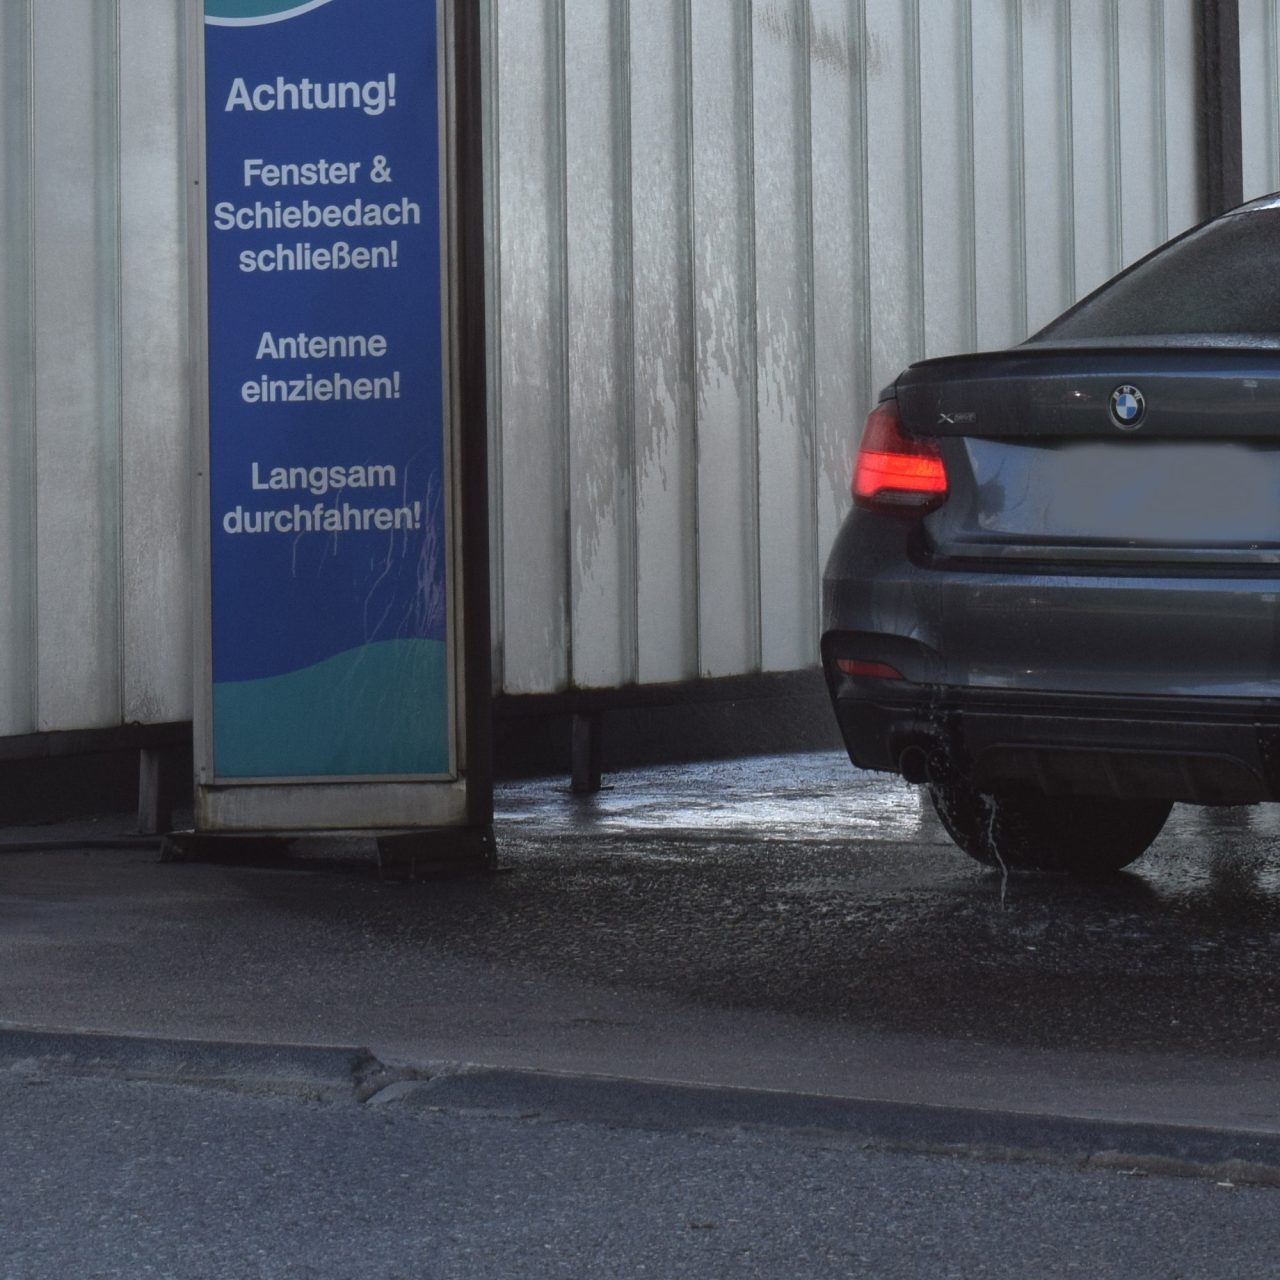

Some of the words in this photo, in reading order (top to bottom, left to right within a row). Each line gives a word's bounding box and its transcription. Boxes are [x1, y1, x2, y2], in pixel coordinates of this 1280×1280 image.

[224, 72, 397, 116] Achtung!
[243, 158, 361, 187] Fenster
[369, 154, 392, 184] &
[213, 197, 421, 231] Schiebedach
[239, 239, 399, 273] schließen!
[255, 331, 387, 360] Antenne
[241, 371, 400, 403] einziehen!
[251, 462, 396, 495] Langsam
[223, 501, 421, 534] durchfahren!
